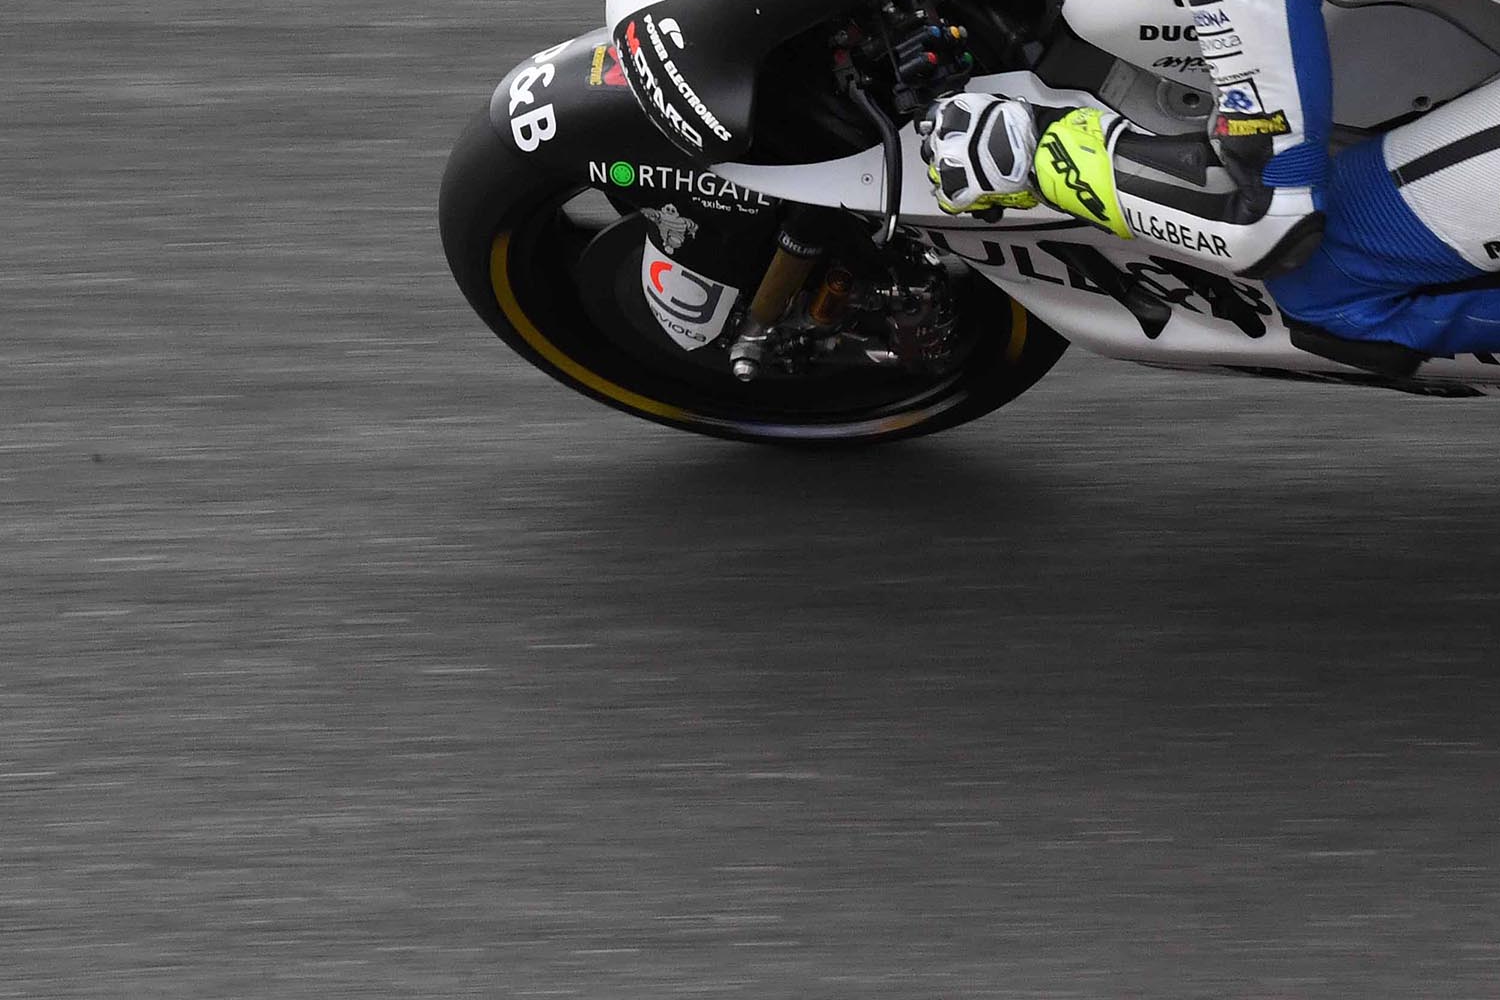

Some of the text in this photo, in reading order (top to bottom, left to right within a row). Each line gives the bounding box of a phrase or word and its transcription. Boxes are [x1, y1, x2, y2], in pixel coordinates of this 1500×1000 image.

[1139, 24, 1199, 43] DUC
[643, 13, 732, 142] POWER ELECTRONICS
[1126, 207, 1233, 259] LL&BEAR
